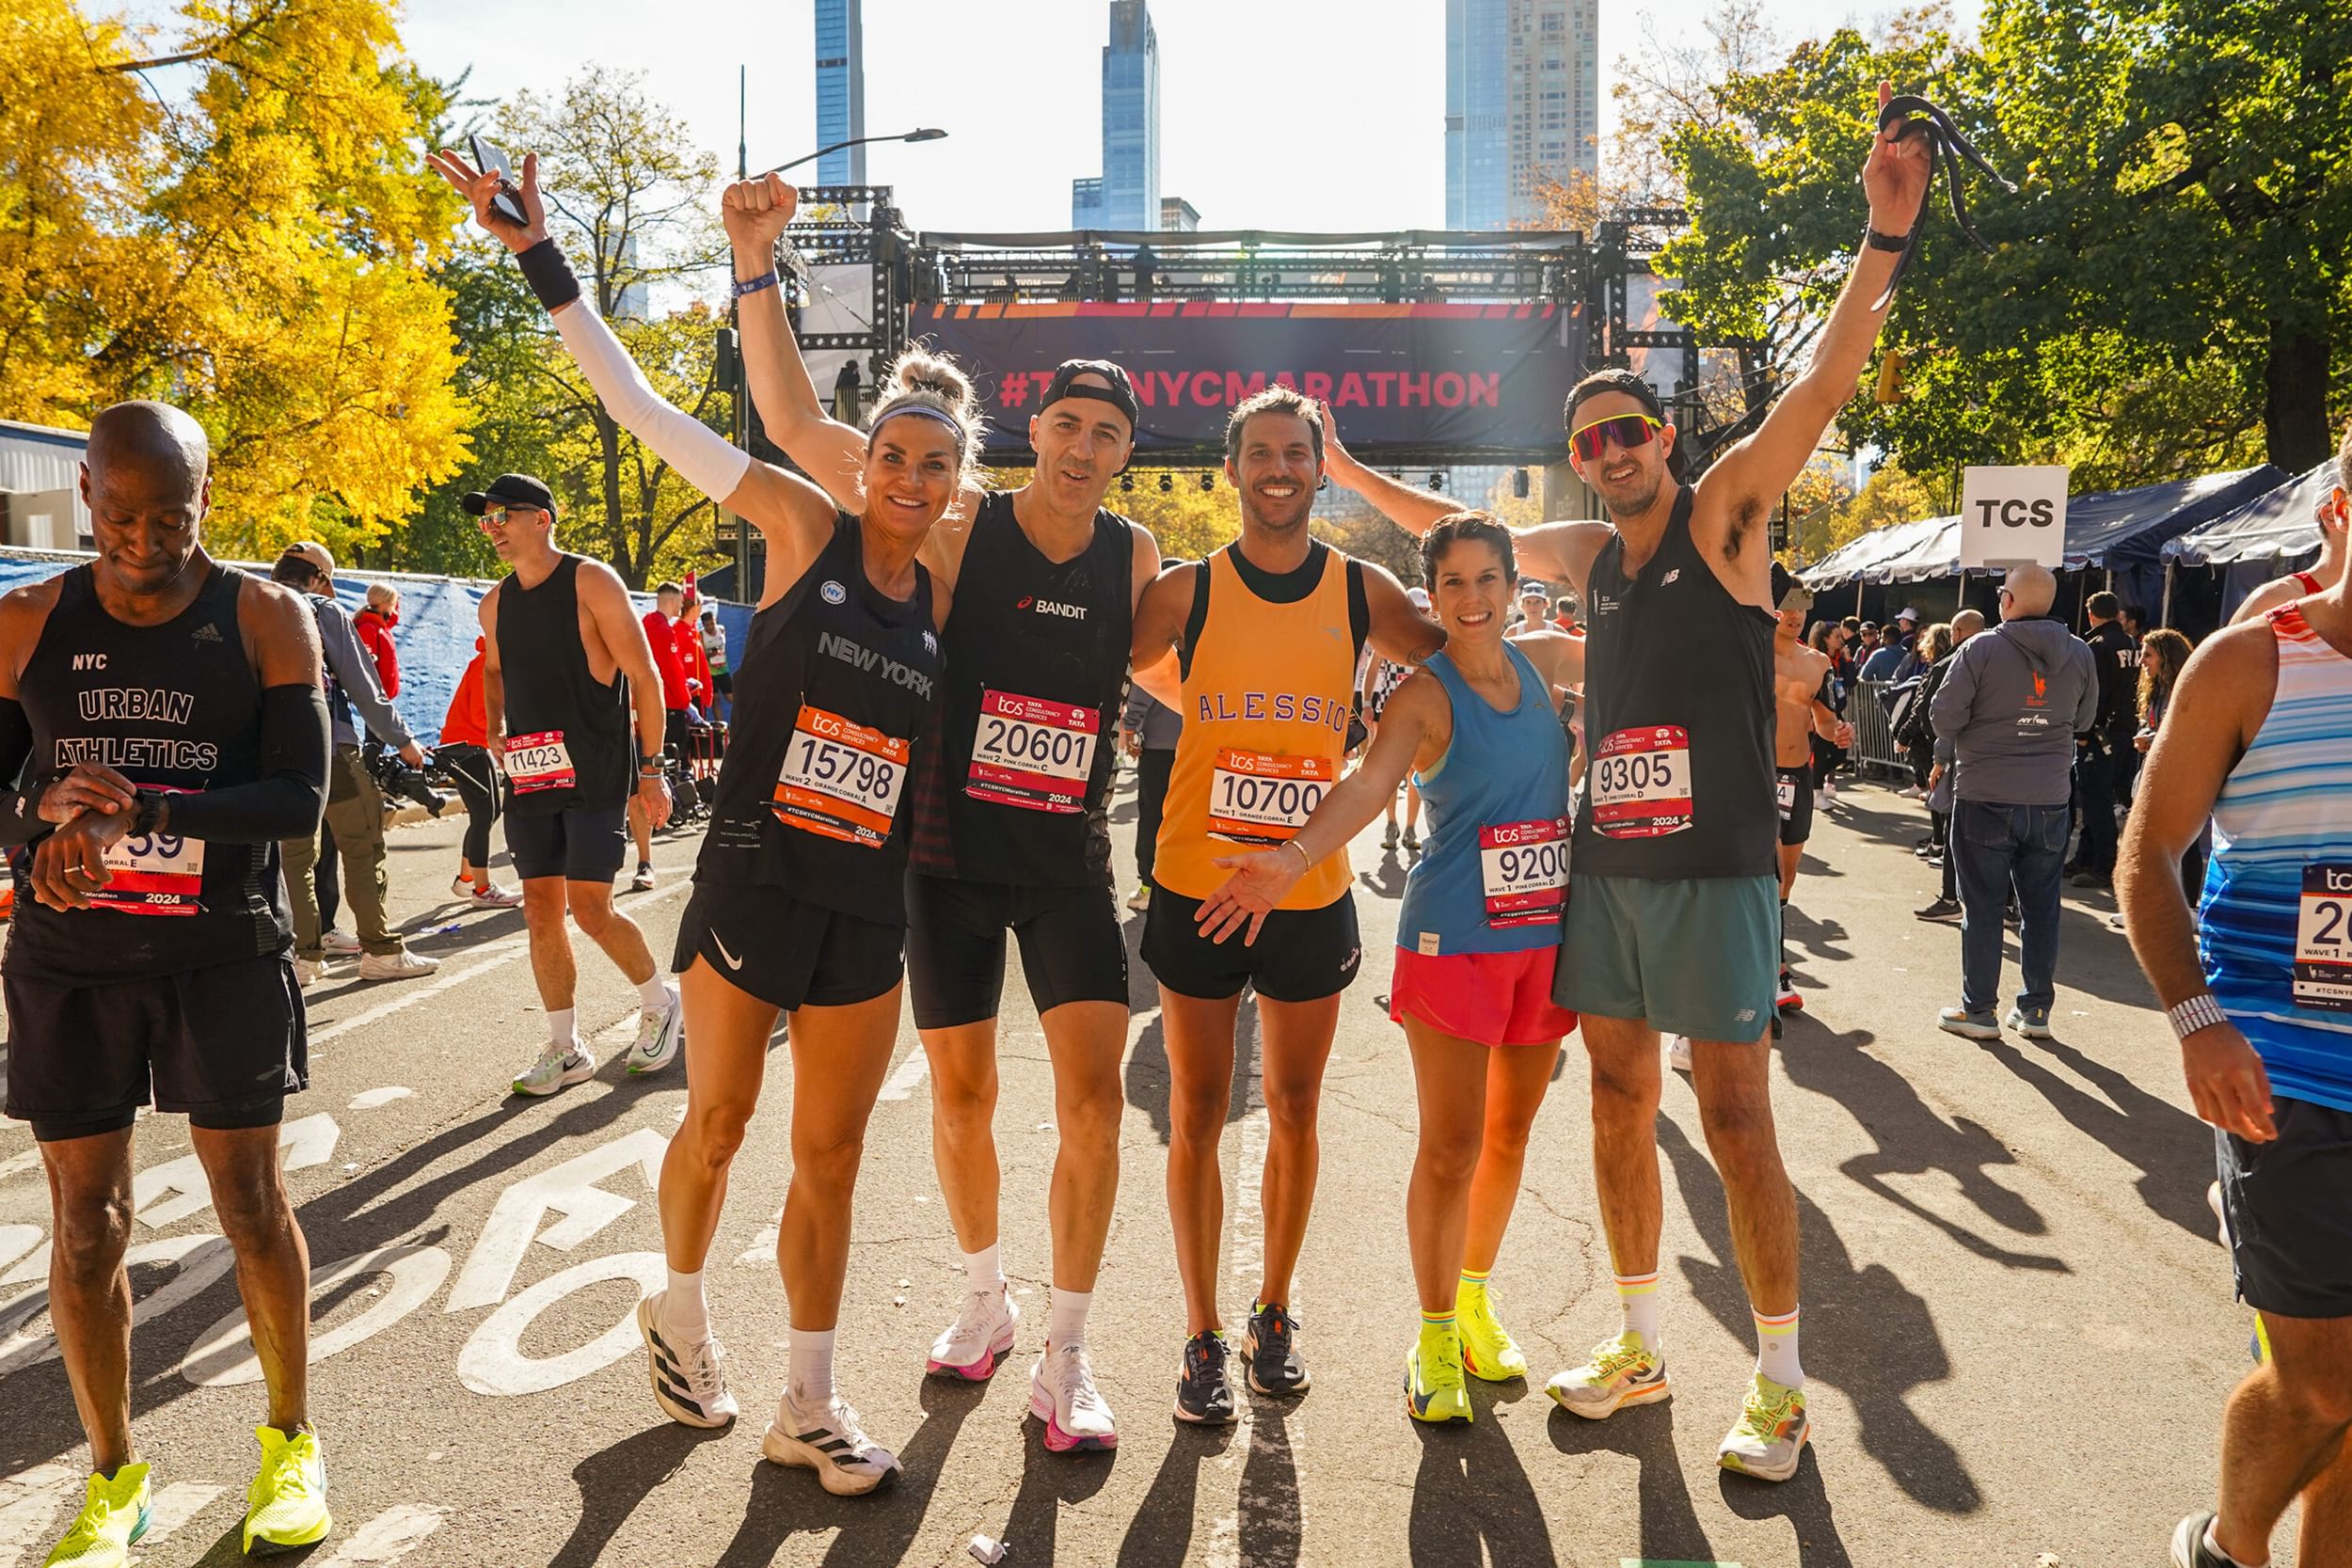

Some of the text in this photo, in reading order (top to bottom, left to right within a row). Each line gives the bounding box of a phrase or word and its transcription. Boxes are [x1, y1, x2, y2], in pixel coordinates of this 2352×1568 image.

[999, 371, 1500, 407] #TNYCMRATHON
[1976, 499, 2054, 528] TCS
[827, 587, 842, 597] NY
[1036, 600, 1088, 620] BANDIT
[72, 654, 107, 670] NYC
[818, 631, 934, 702] NEW YORK
[78, 688, 195, 725] URBAN
[998, 695, 1025, 716] tcs
[1025, 706, 1061, 718] CONSULTANCY
[1199, 692, 1346, 735] ALESSIO
[813, 713, 842, 736] tcs
[845, 721, 861, 731] TATA
[1025, 712, 1047, 721] SERVICES
[1068, 719, 1086, 728] TATA
[843, 727, 879, 744] CONSULTANCY
[984, 720, 1087, 768] 20601
[56, 737, 218, 771] ATHLETICS
[511, 747, 562, 771] 11423
[882, 747, 898, 757] TATA
[977, 752, 993, 761] WAVE
[994, 755, 1001, 764] 2
[1018, 761, 1040, 770] CORRAL
[1231, 752, 1255, 770] tcs
[802, 739, 894, 799] 15798
[1601, 753, 1672, 793] 9305
[786, 773, 803, 784] WAVE
[803, 778, 811, 786] 2
[814, 782, 838, 793] ORANGE
[838, 789, 861, 800] CORRAL
[980, 783, 1030, 797] #TCSNYCMarathon
[1223, 775, 1322, 816] 10700
[1048, 793, 1072, 804] 2024
[787, 807, 839, 826] #TCSNYCMarathon
[1239, 812, 1263, 820] ORANGE
[1652, 816, 1679, 826] 2024
[1494, 828, 1518, 844] tcs
[130, 859, 137, 867] E
[1500, 842, 1567, 882] 9200
[2326, 868, 2352, 891] tc
[146, 893, 181, 904] 2024
[2312, 900, 2352, 945] 2
[2304, 948, 2339, 958] WAVE 1
